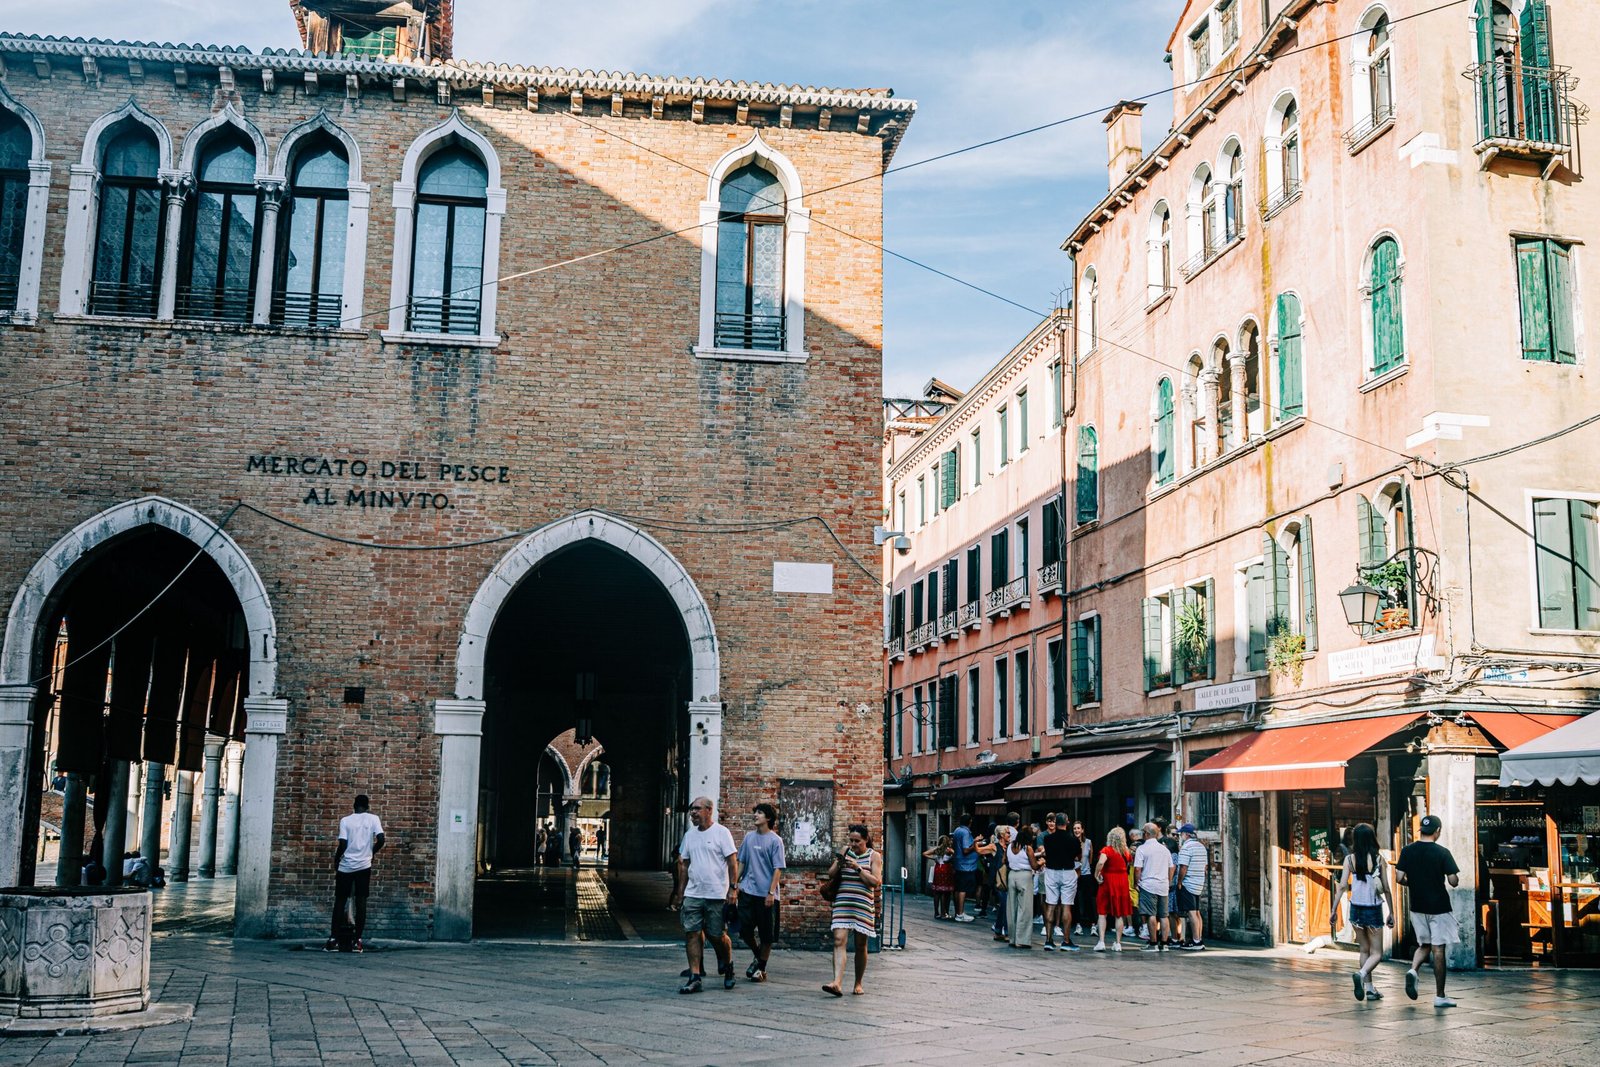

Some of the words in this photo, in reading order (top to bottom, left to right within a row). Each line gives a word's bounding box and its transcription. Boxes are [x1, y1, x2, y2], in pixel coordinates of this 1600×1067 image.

[381, 461, 427, 480] DEL
[439, 463, 511, 483] PESCE
[303, 487, 338, 506] AL
